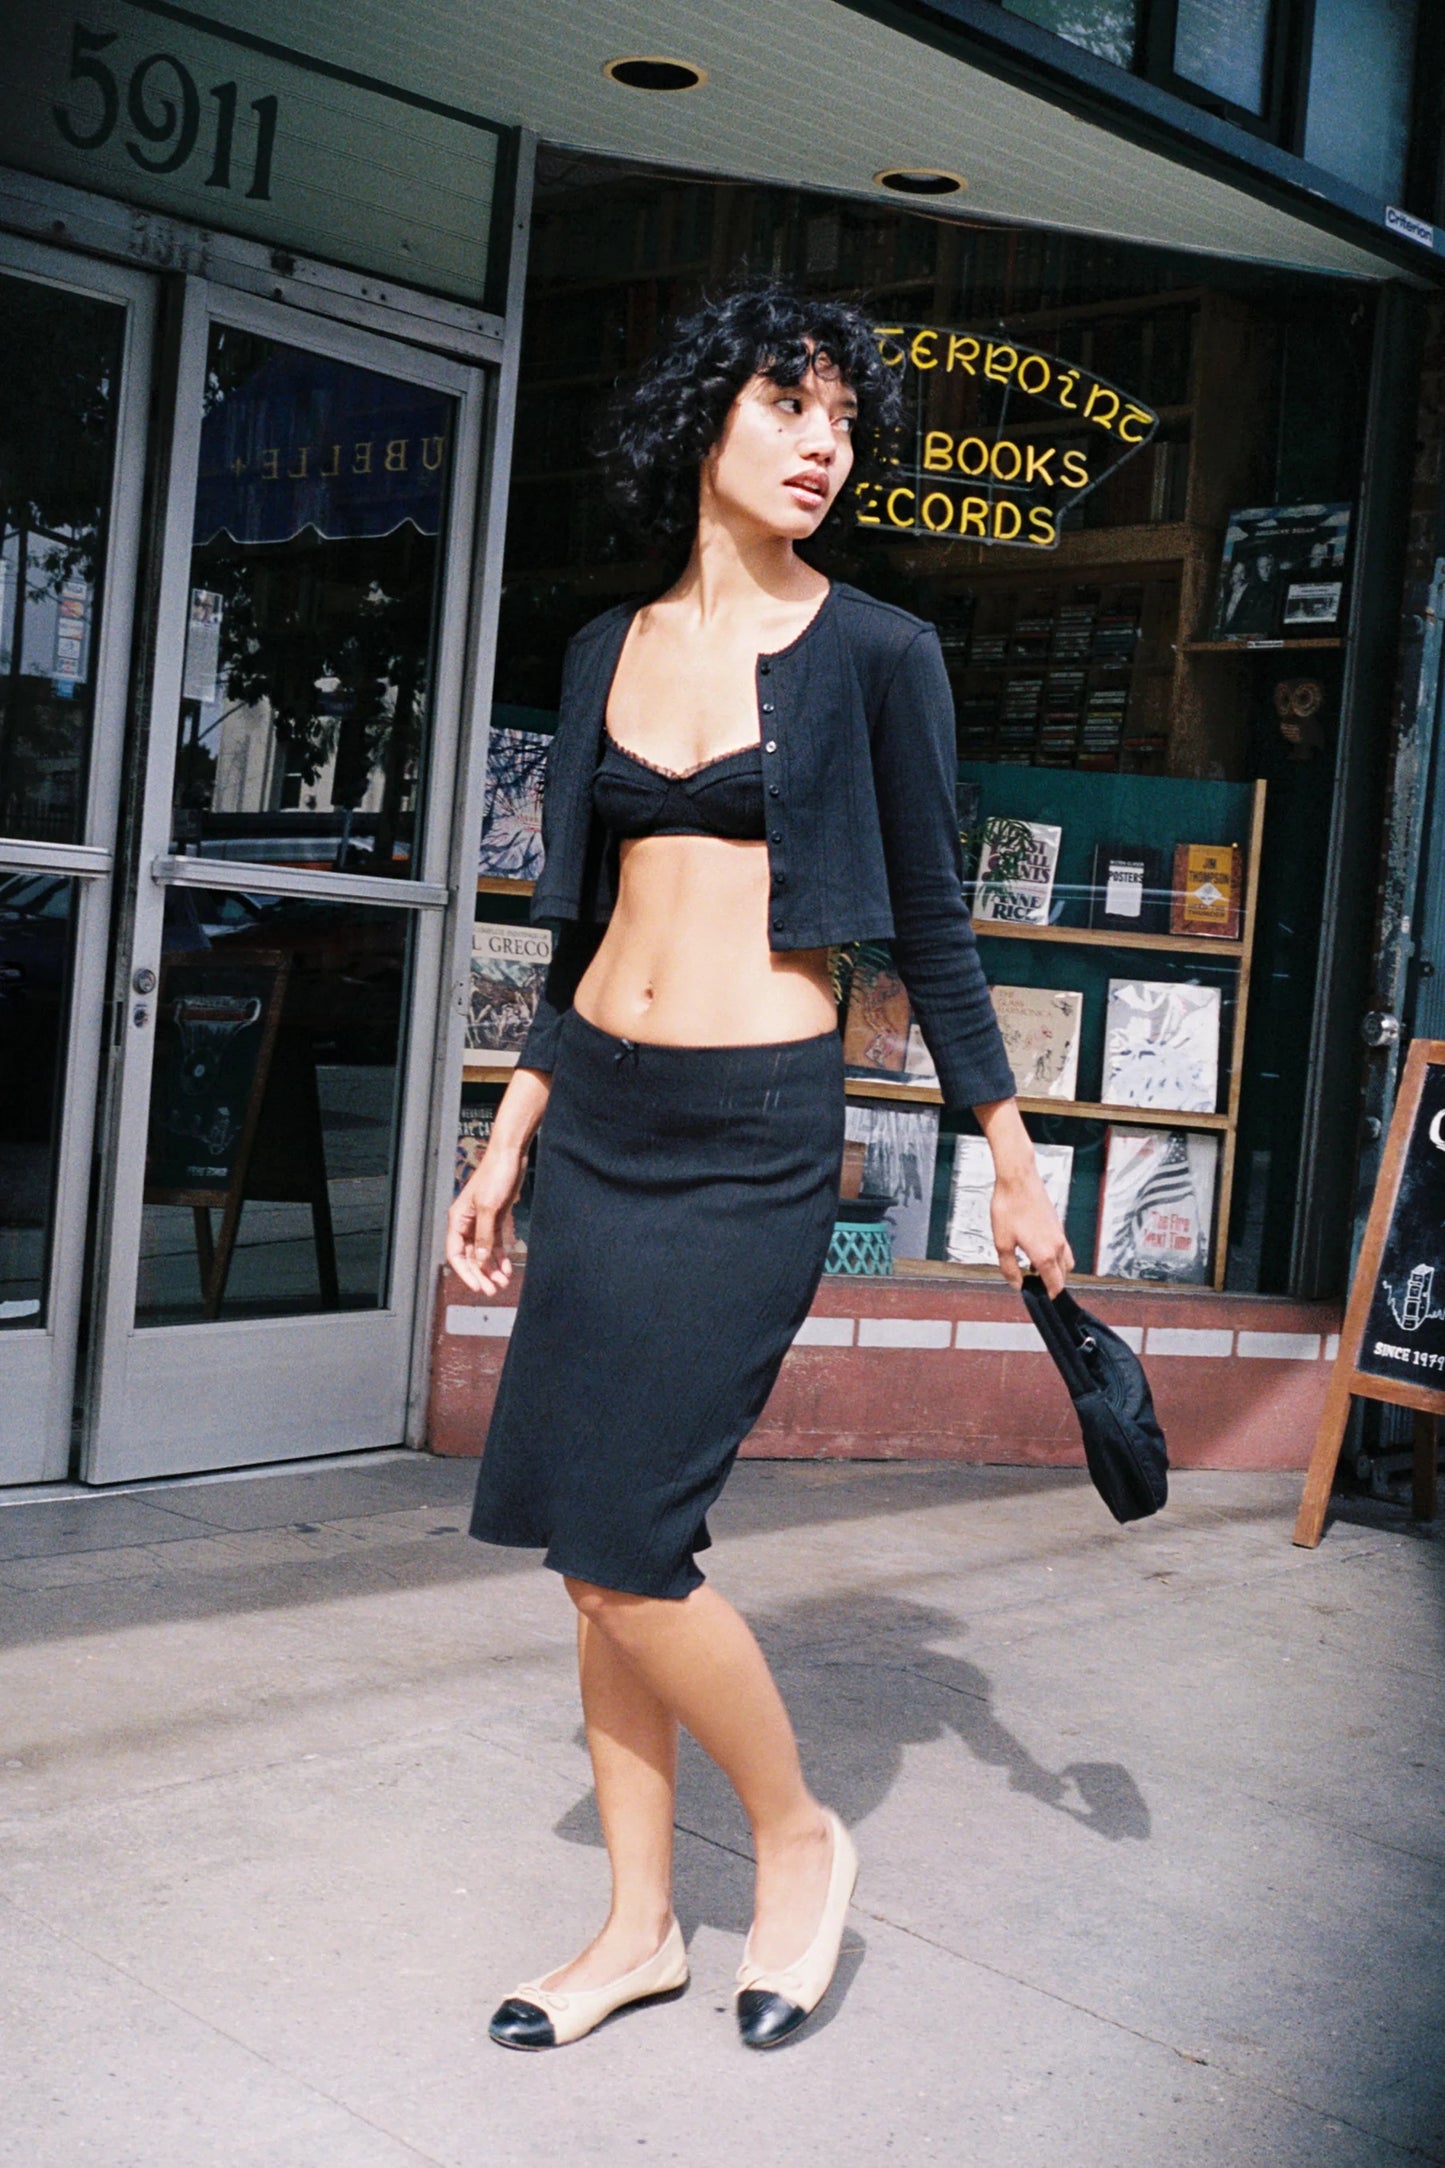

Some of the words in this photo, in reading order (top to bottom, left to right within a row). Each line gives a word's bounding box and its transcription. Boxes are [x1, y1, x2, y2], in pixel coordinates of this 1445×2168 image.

[53, 21, 279, 201] 5911
[1388, 209, 1433, 241] Criterion
[923, 431, 1089, 488] BOOKS
[1109, 871, 1144, 883] POSTERS
[1188, 870, 1230, 884] THOMPSON
[488, 936, 550, 958] GRECO
[1169, 1213, 1190, 1232] Fire
[1169, 1232, 1192, 1250] Time
[1373, 1341, 1410, 1363] SINCE
[1412, 1350, 1445, 1371] 1979
